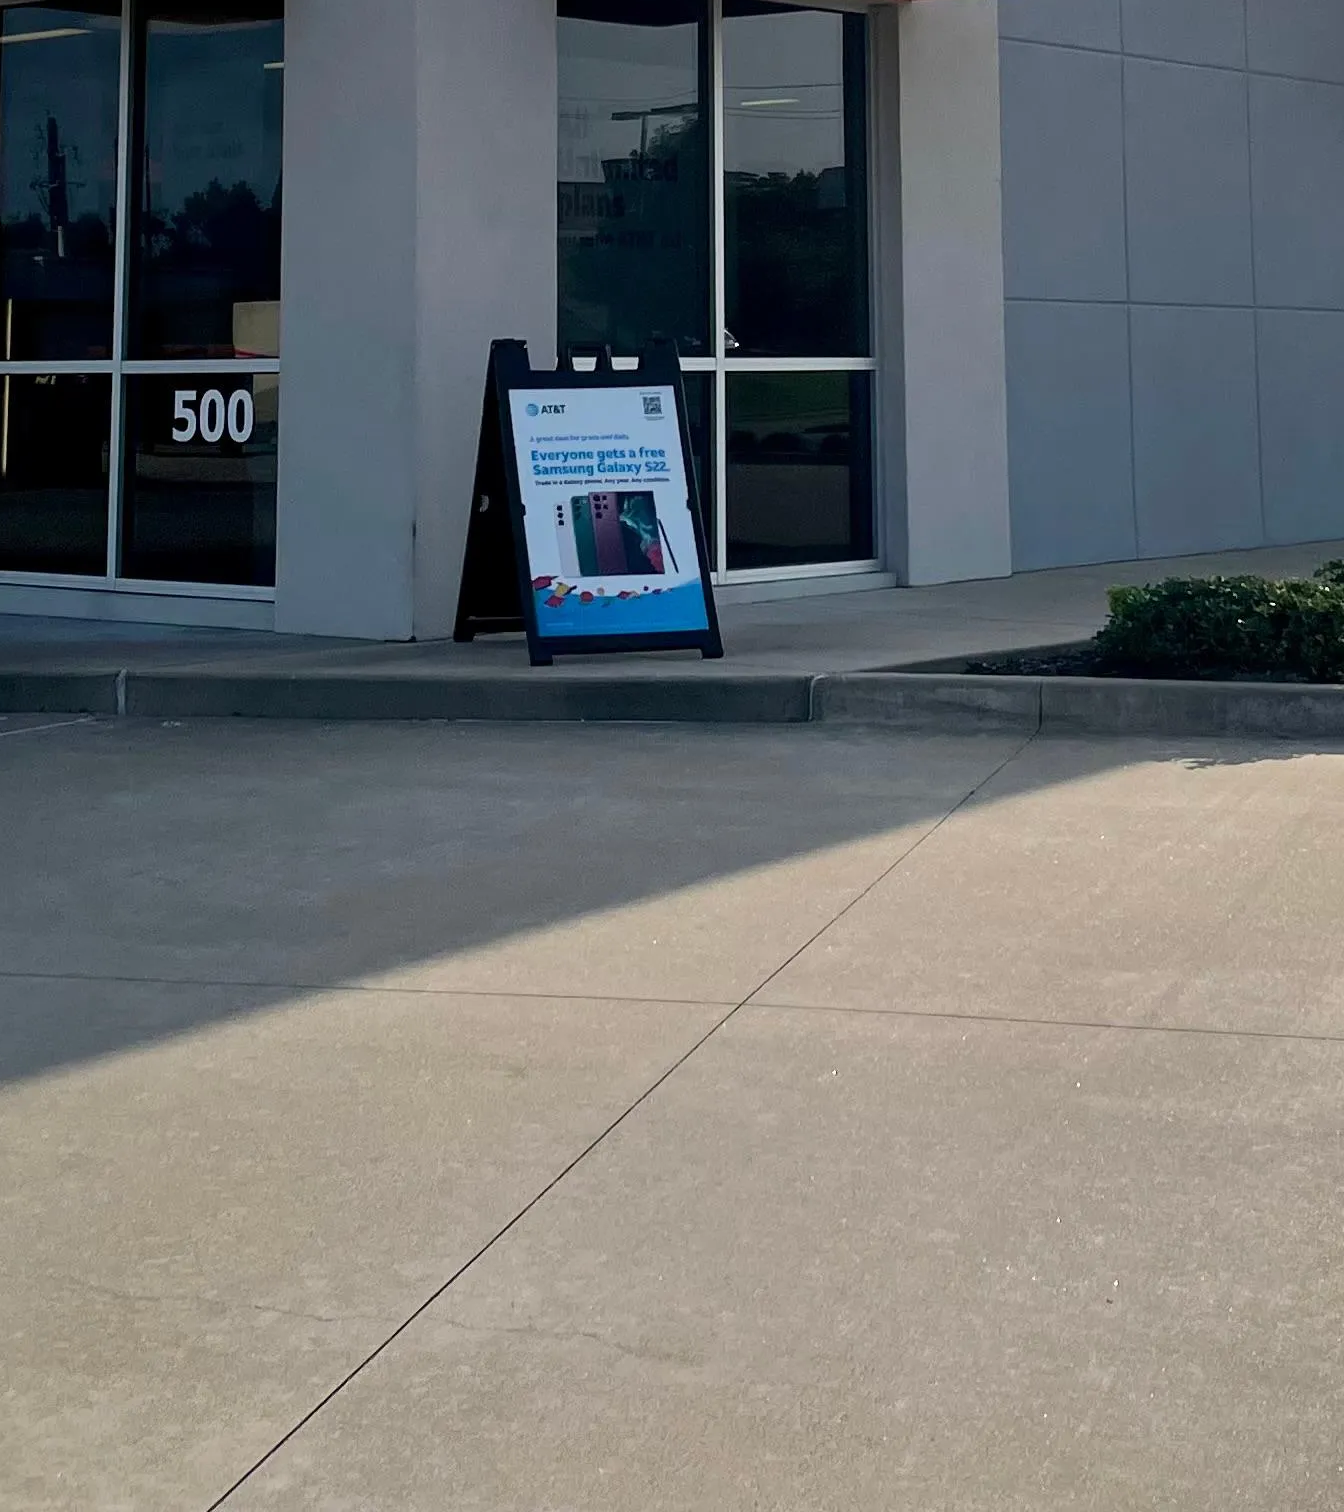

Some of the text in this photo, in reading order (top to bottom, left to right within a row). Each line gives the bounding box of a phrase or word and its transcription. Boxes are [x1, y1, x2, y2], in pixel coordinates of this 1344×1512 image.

[171, 389, 254, 444] 500
[541, 404, 566, 414] AT&T
[531, 446, 666, 463] Everyone gets a free
[533, 464, 594, 476] Samsung
[597, 462, 642, 476] Galaxy
